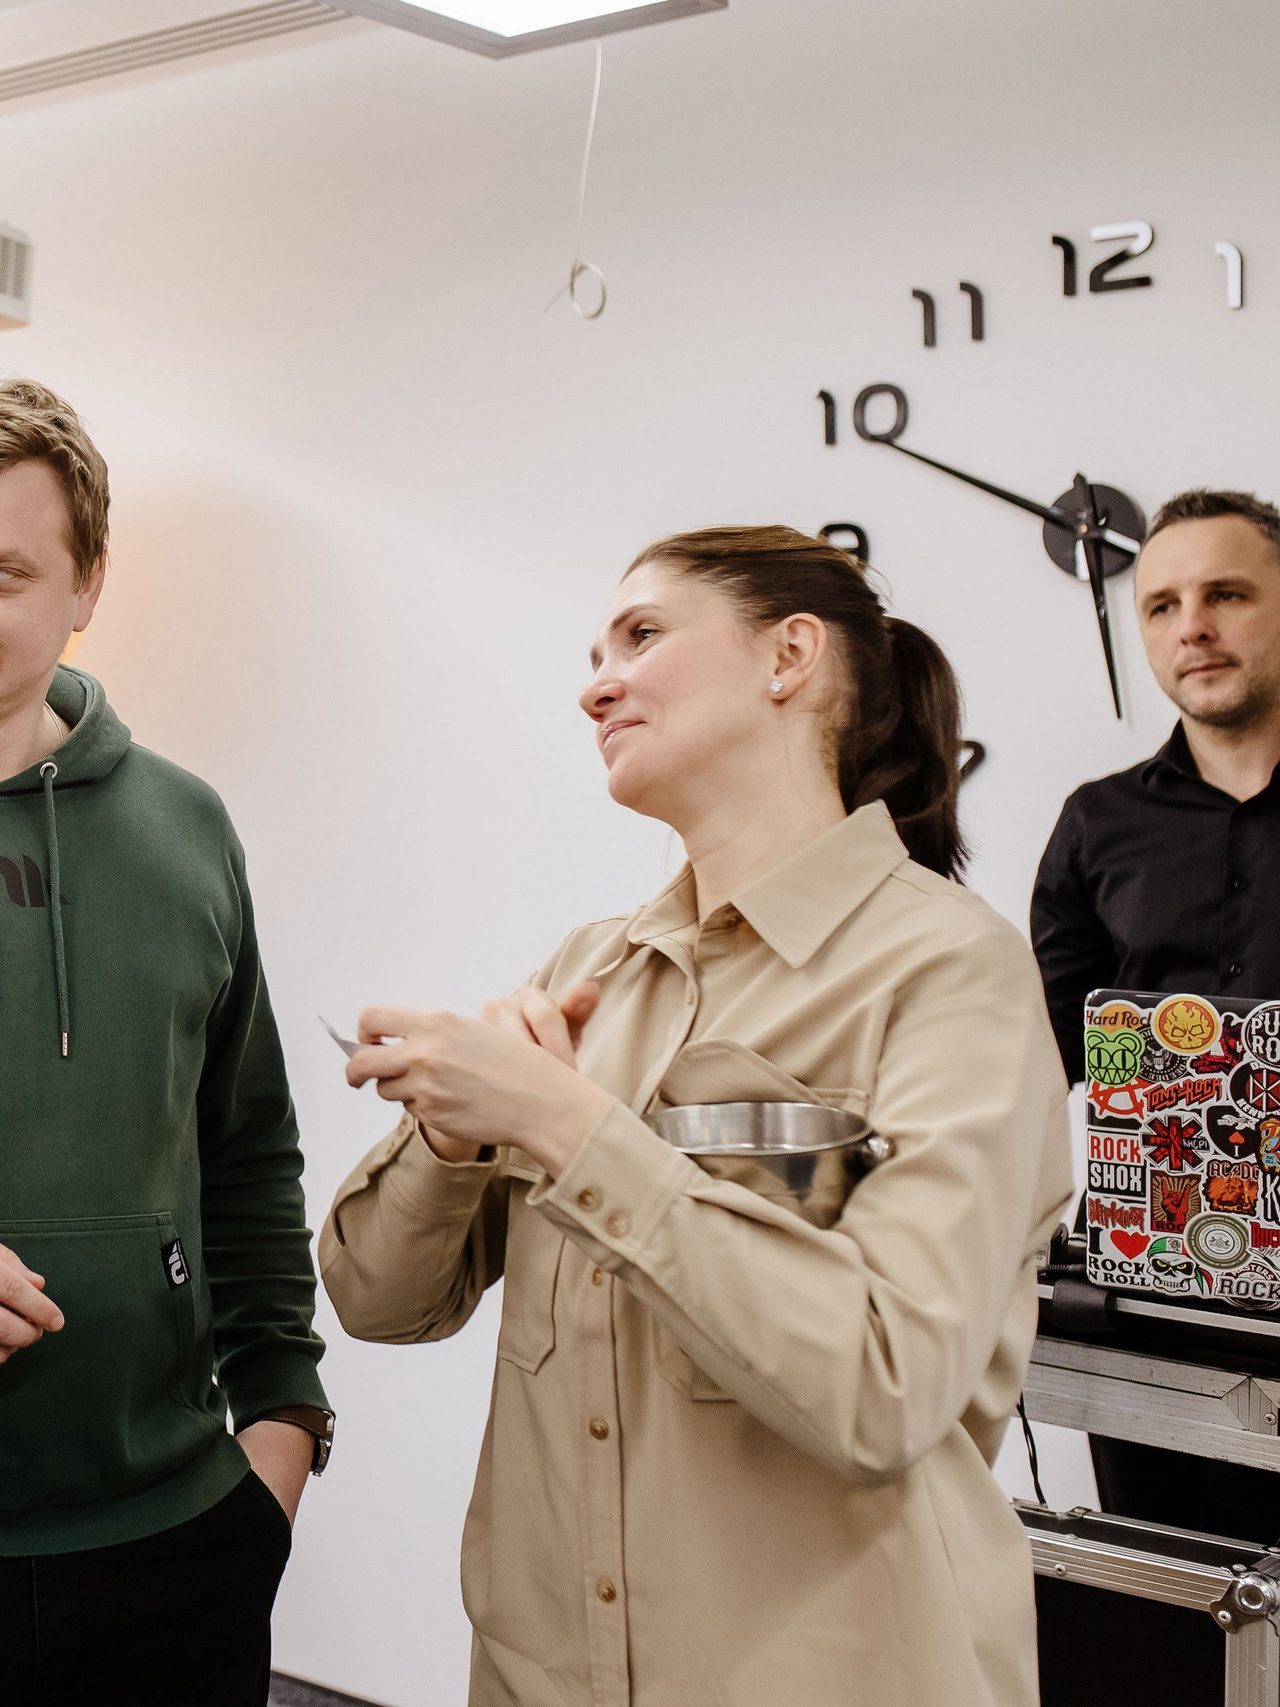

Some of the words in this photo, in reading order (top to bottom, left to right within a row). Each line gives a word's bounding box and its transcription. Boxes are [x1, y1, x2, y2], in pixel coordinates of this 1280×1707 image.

[1051, 220, 1154, 297] 12
[1214, 240, 1243, 310] 1
[911, 280, 986, 348] 11
[815, 382, 910, 447] 10
[1086, 1010, 1118, 1026] Hard
[1183, 1078, 1222, 1106] ROCK
[1090, 1135, 1142, 1164] ROCK
[1090, 1162, 1142, 1192] SHOX
[1088, 1225, 1104, 1255] I
[1156, 1221, 1185, 1232] ROC
[1088, 1255, 1146, 1276] ROCK
[1088, 1269, 1098, 1281] N
[1103, 1272, 1151, 1287] ROLL
[1218, 1278, 1280, 1300] ROCK
